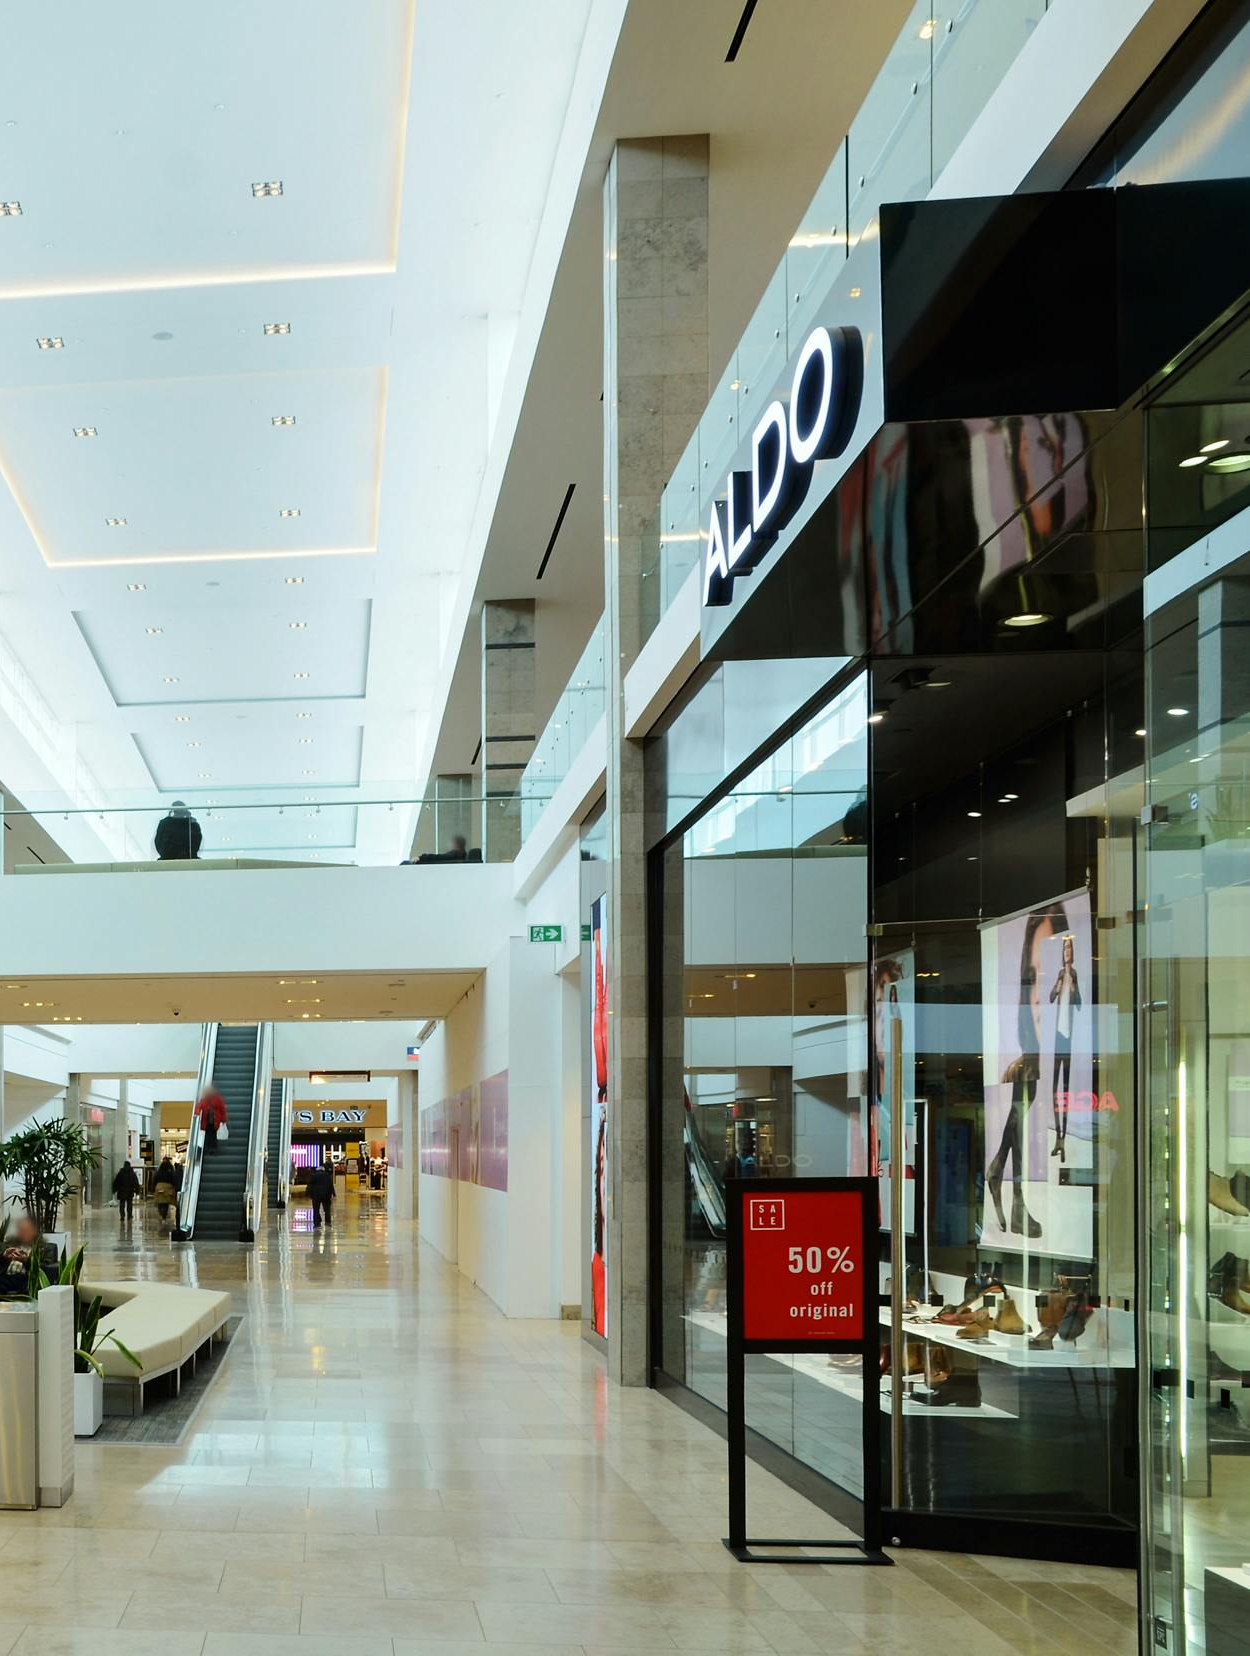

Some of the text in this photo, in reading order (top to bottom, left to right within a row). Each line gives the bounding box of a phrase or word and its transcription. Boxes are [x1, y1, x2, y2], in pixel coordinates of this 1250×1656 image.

[702, 325, 833, 608] ALDO
[320, 1110, 367, 1123] BAY
[788, 1246, 855, 1274] 50%
[810, 1281, 833, 1295] off
[789, 1303, 854, 1320] original
